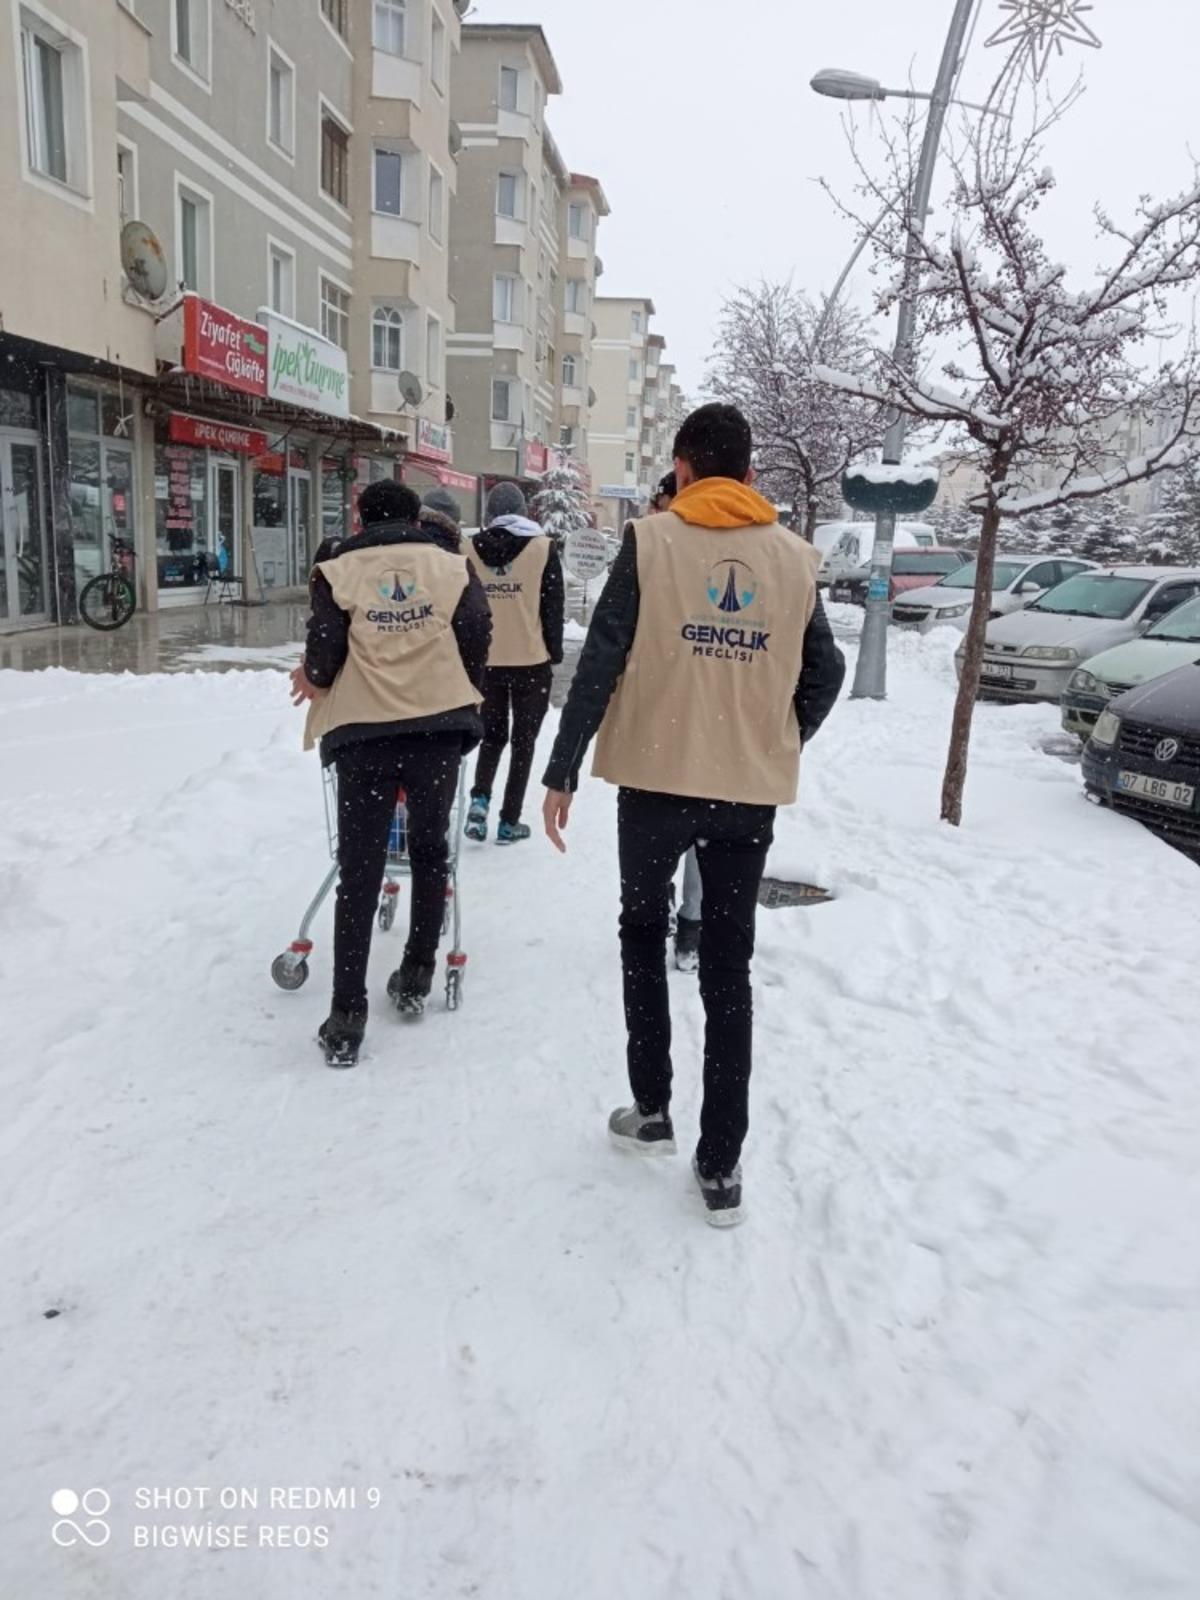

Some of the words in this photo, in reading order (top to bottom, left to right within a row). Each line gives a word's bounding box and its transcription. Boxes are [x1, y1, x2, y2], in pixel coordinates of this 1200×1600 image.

[200, 311, 241, 351] Ziyafet
[1123, 773, 1139, 790] 07
[1143, 778, 1168, 798] LBG
[1173, 785, 1192, 804] 02
